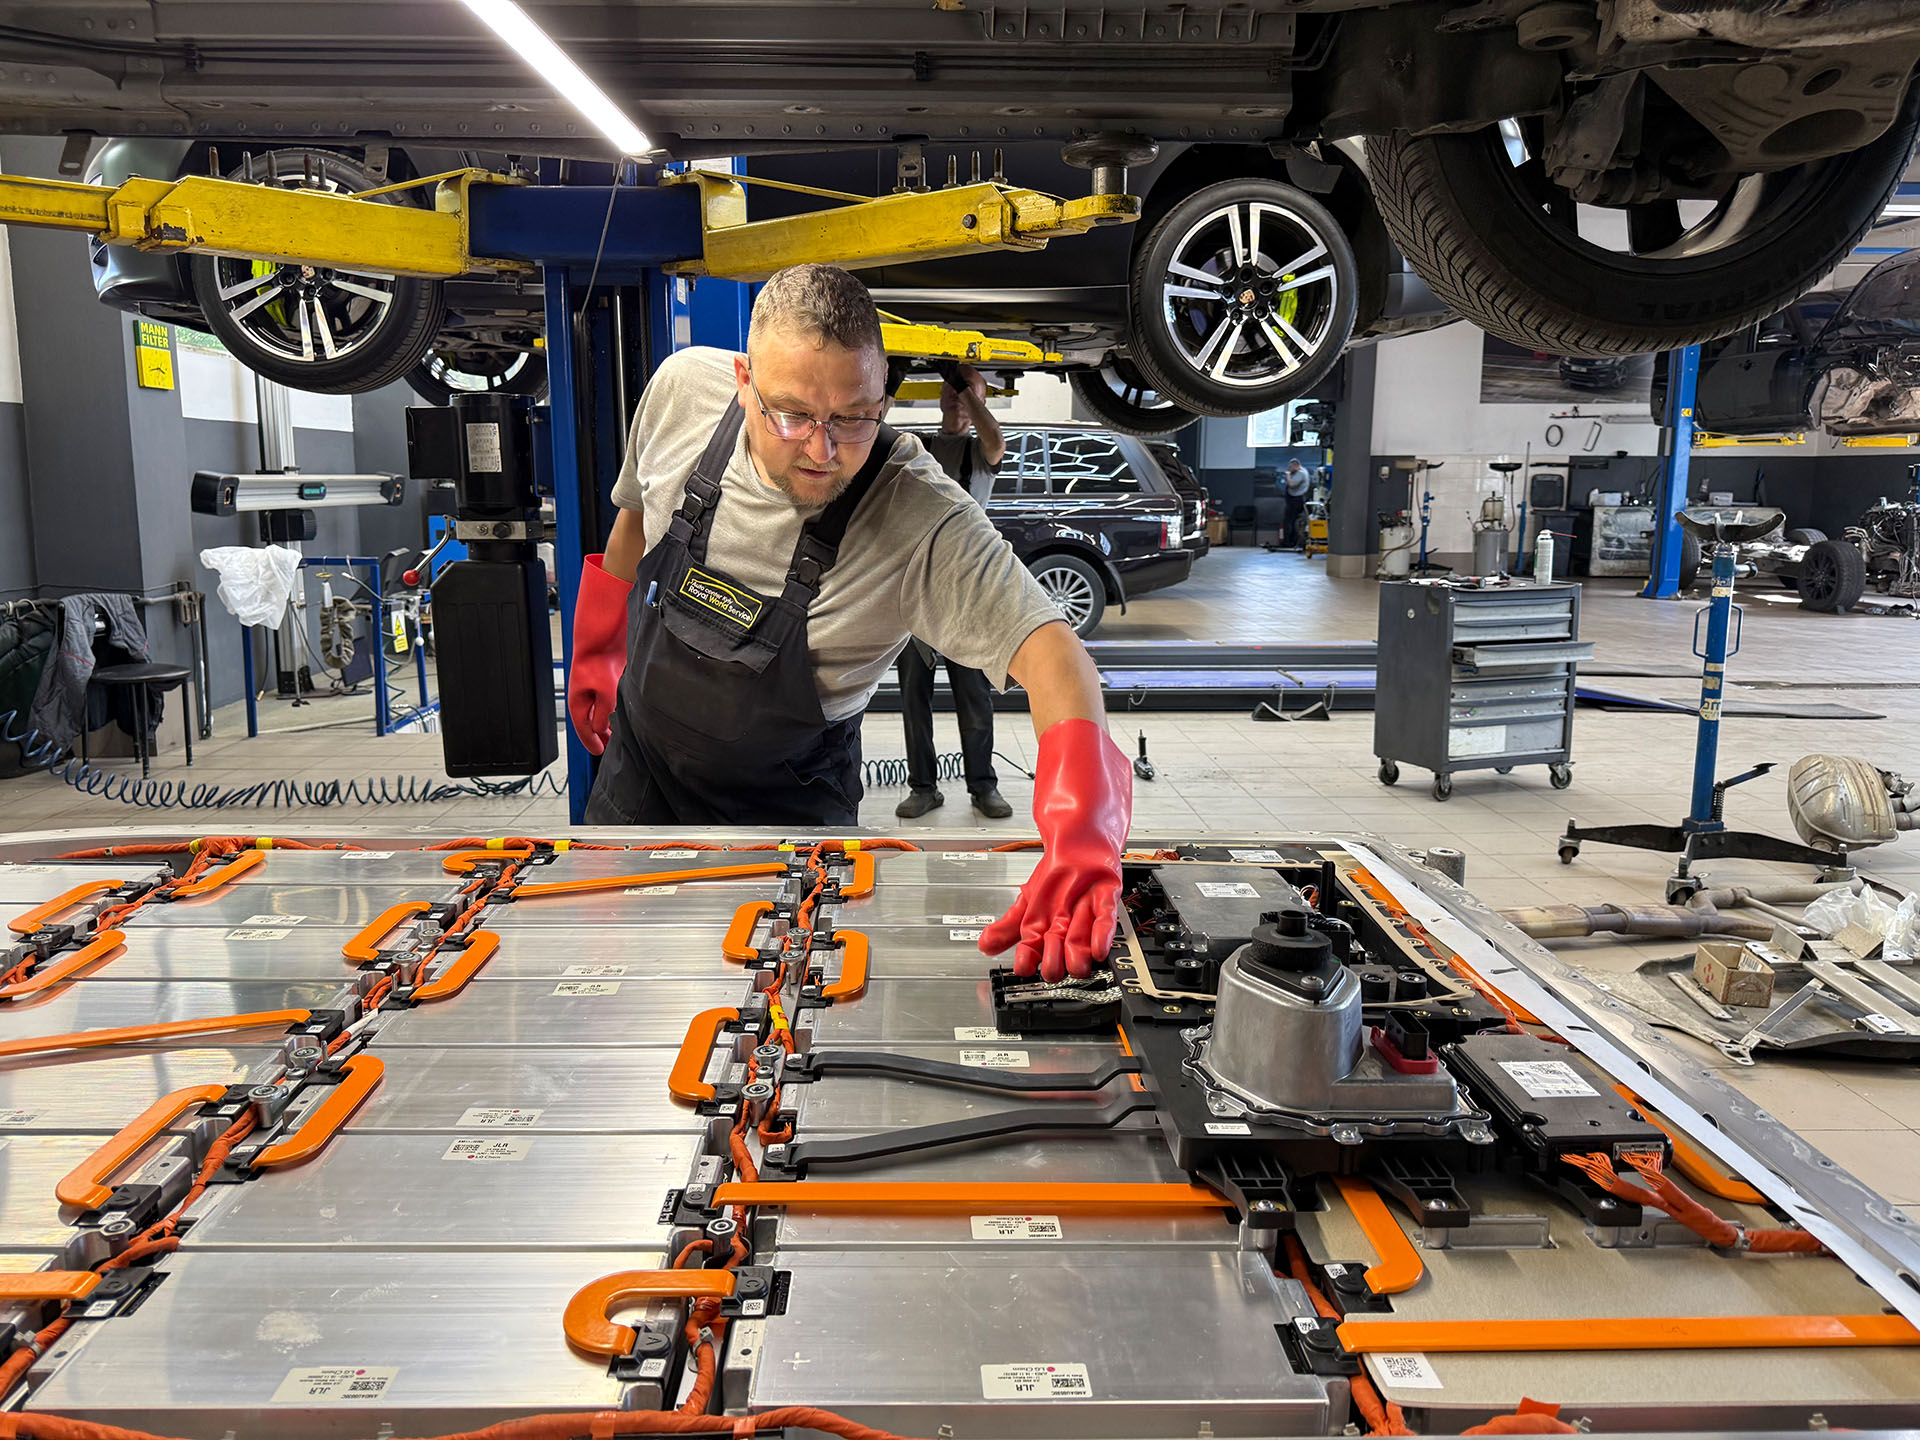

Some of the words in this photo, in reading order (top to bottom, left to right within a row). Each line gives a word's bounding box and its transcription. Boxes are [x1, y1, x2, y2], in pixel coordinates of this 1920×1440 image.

[140, 322, 168, 337] MANN
[141, 333, 169, 348] FILTER
[692, 582, 704, 590] Auto
[705, 589, 722, 599] center
[688, 585, 709, 600] Royal
[709, 595, 729, 610] World
[728, 605, 751, 621] Service
[308, 1386, 331, 1395] JLR
